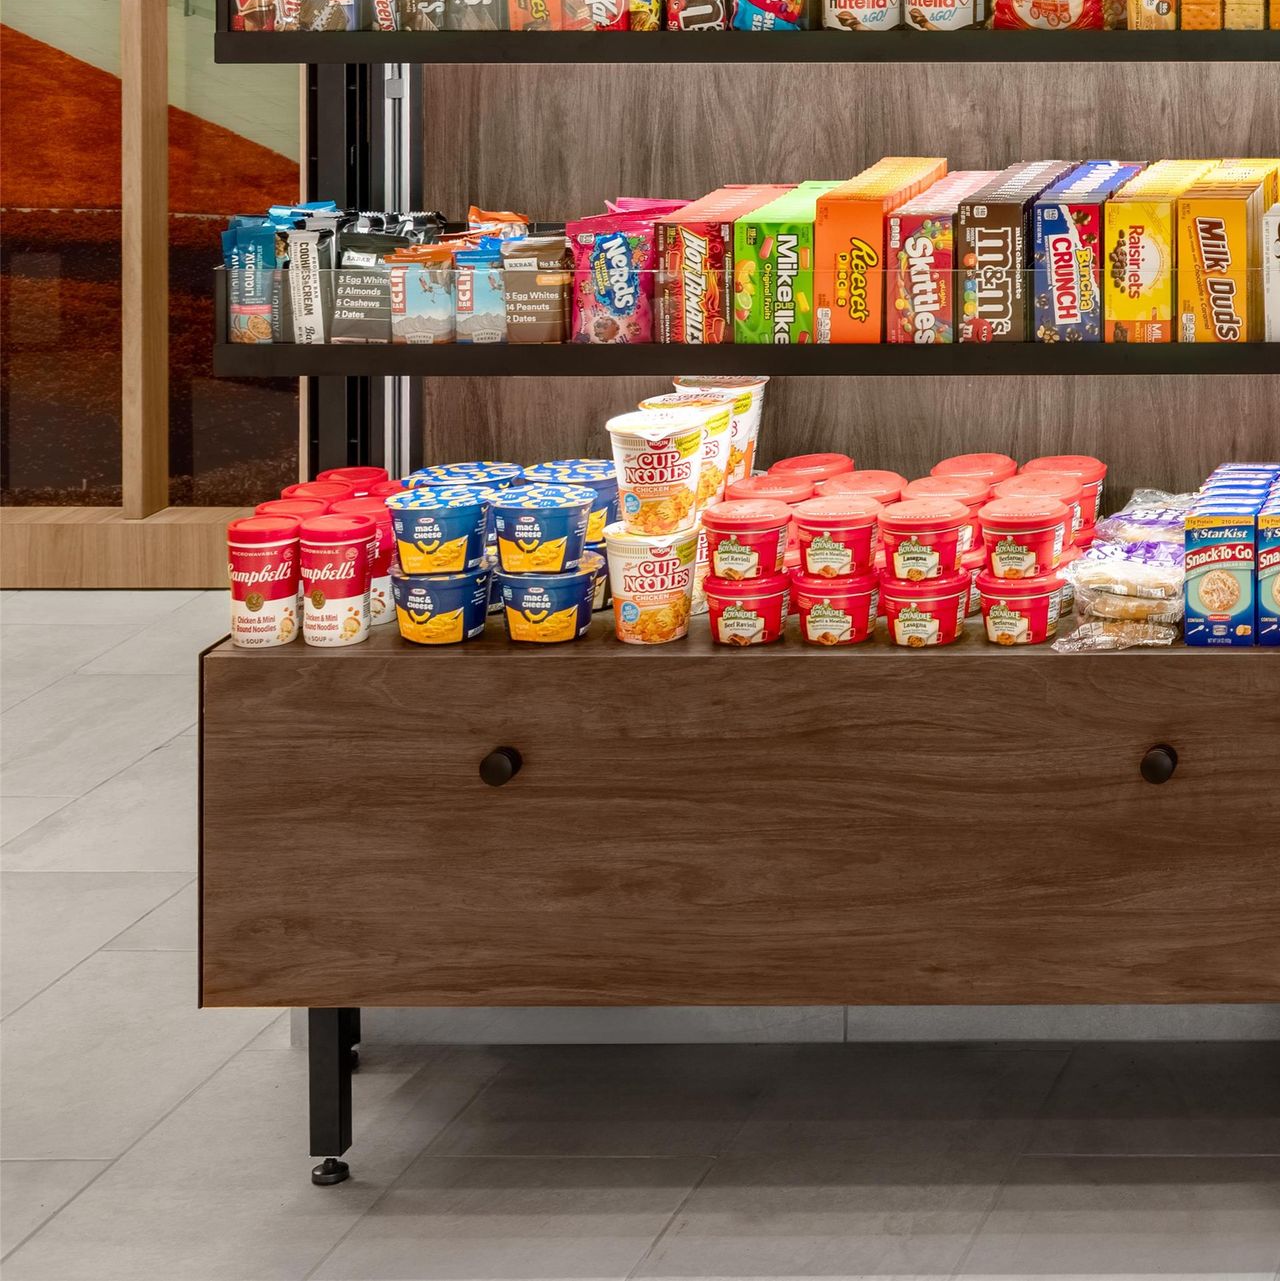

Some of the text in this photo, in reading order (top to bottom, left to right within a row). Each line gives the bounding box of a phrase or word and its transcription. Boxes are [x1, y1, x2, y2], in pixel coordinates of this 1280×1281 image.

[1195, 217, 1231, 274] Milk
[1128, 224, 1145, 300] Raisinets
[850, 236, 879, 323] Reese's
[345, 287, 381, 296] Almonds
[512, 291, 559, 300] Egg Whites
[343, 299, 380, 307] Cashews
[625, 463, 691, 483] NOODLES
[1200, 528, 1247, 539] StarKist
[639, 559, 681, 576] CUP
